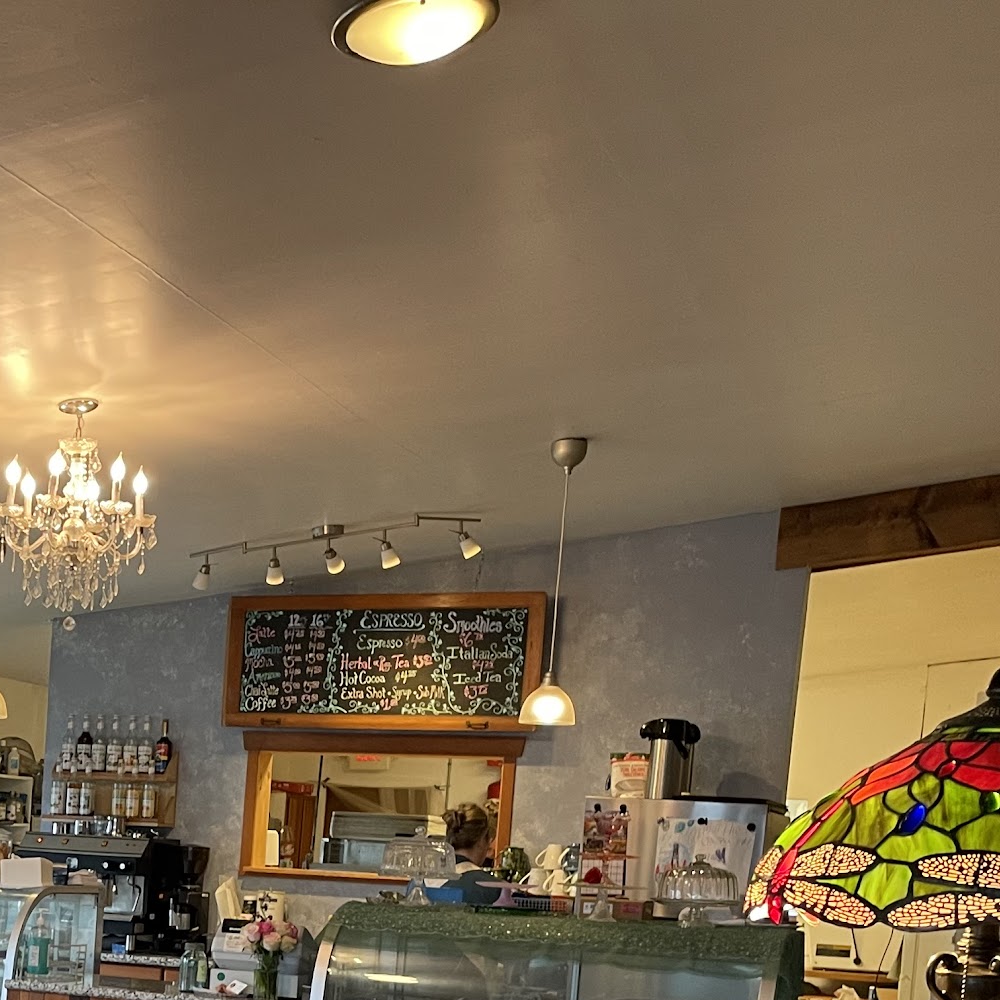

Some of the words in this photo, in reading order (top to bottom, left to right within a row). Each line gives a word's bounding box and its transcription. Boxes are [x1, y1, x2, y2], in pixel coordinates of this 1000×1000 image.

[443, 611, 502, 633] Smoothies
[356, 634, 403, 655] Espresso
[446, 646, 490, 660] Italian
[490, 642, 513, 661] Soda
[340, 652, 372, 670] Herbal
[391, 654, 410, 669] Tea
[339, 671, 358, 686] Hot
[359, 670, 386, 684] Cocoa
[452, 671, 482, 684] Iced
[482, 671, 502, 683] Tea
[340, 686, 364, 700] Extra
[366, 685, 386, 699] Shot
[245, 697, 277, 712] Coffee
